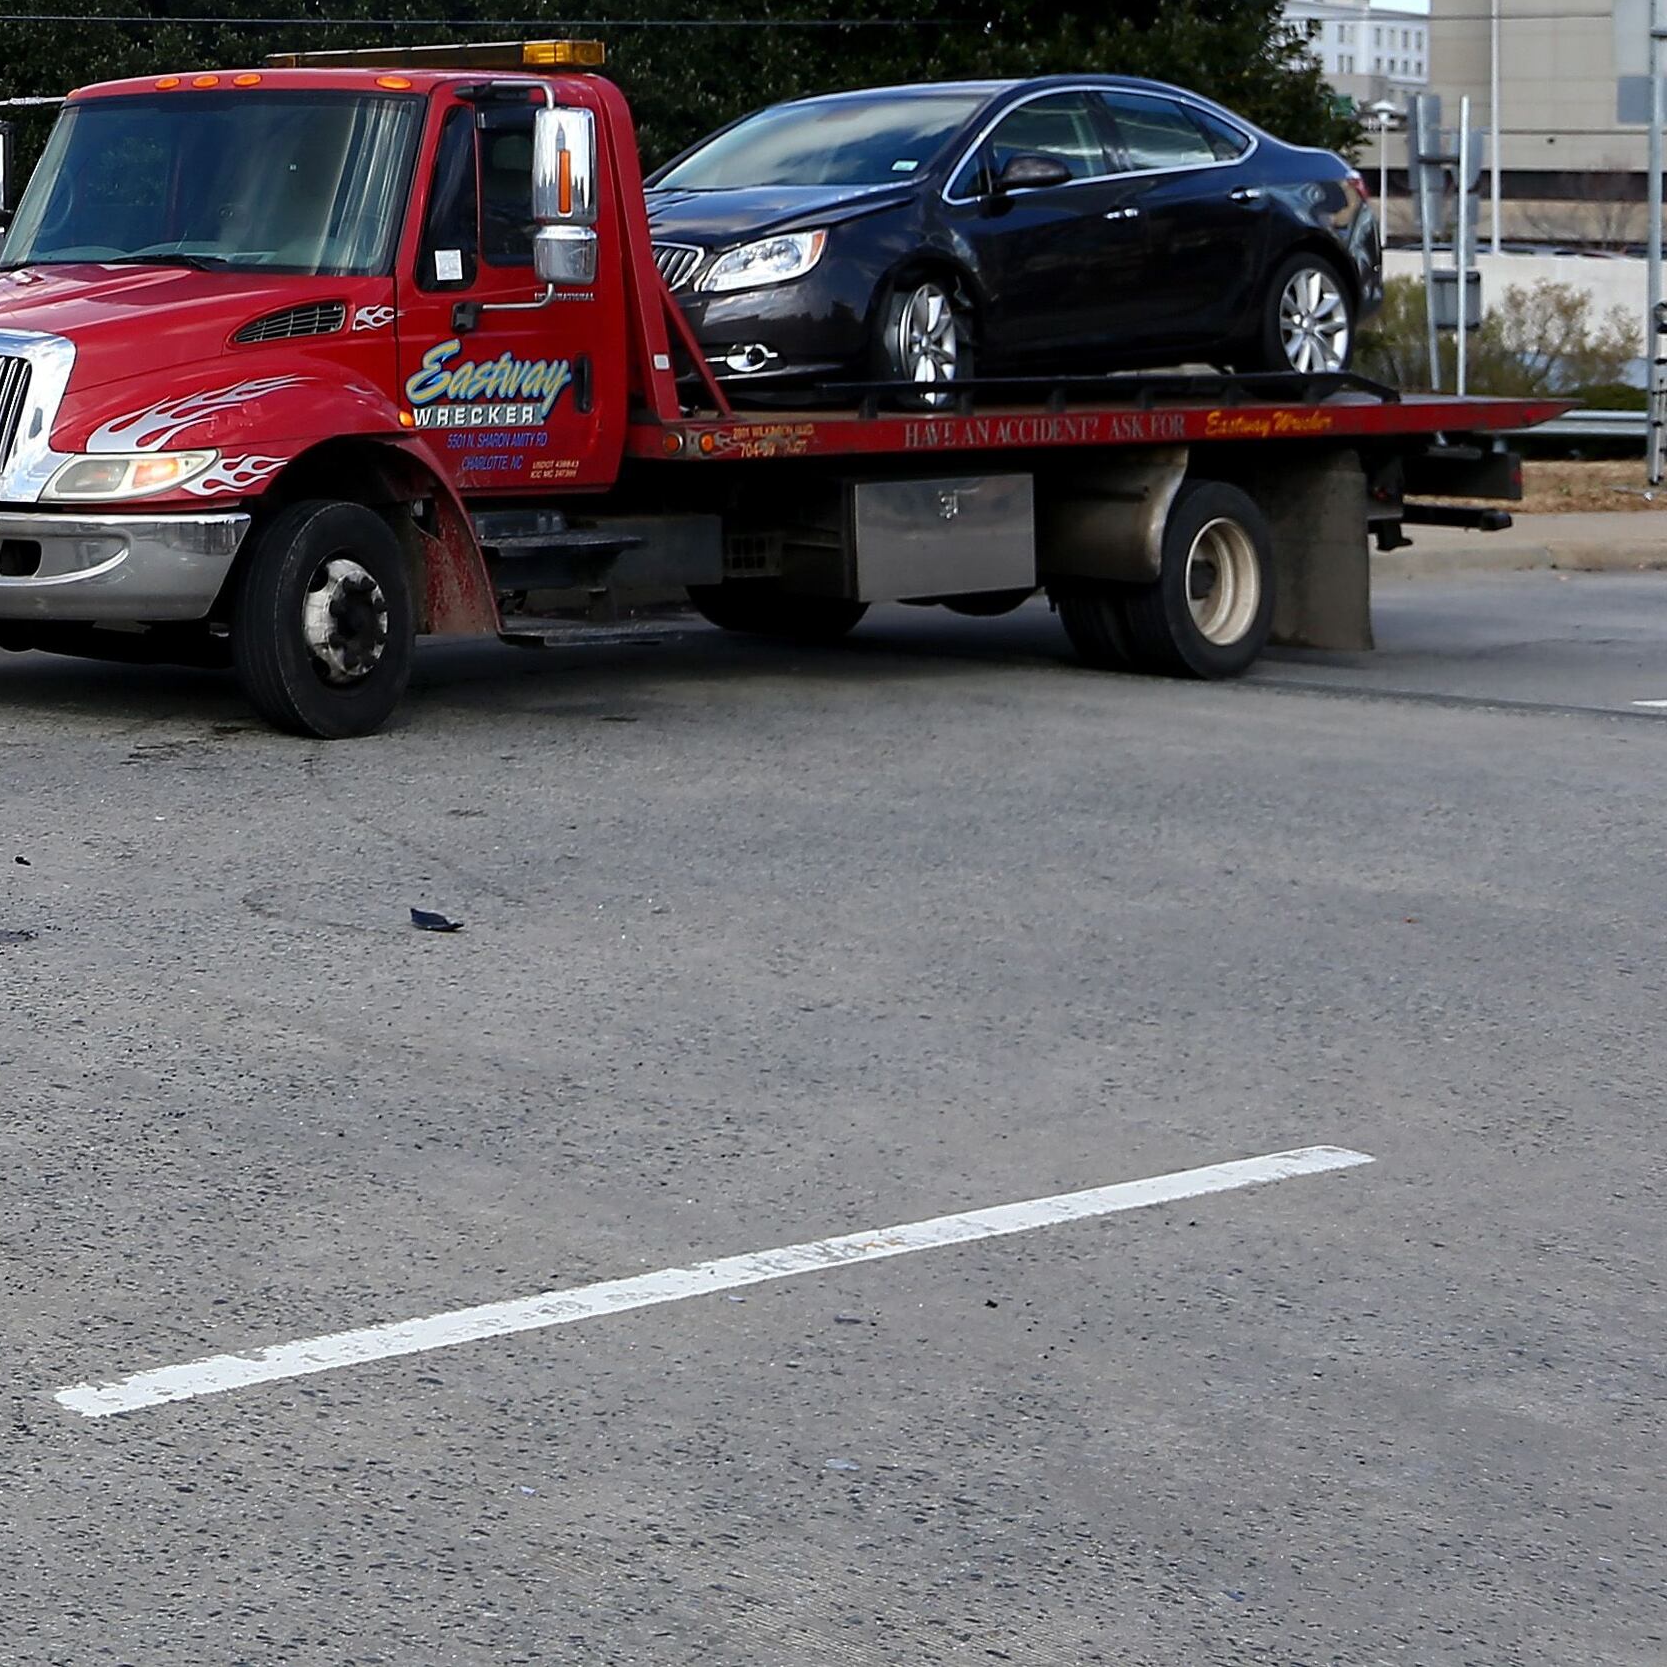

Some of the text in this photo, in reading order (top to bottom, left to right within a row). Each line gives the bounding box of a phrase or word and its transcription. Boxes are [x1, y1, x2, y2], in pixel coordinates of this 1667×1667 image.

[405, 338, 572, 419] Eastway
[413, 406, 534, 426] WRECKER
[905, 422, 956, 447] HAVE
[964, 419, 990, 443] AN
[996, 416, 1098, 442] ACCIDENT?
[1111, 416, 1144, 439] ASK
[1150, 414, 1185, 437] FOR
[1205, 411, 1271, 437] Eastway
[510, 455, 524, 470] NC
